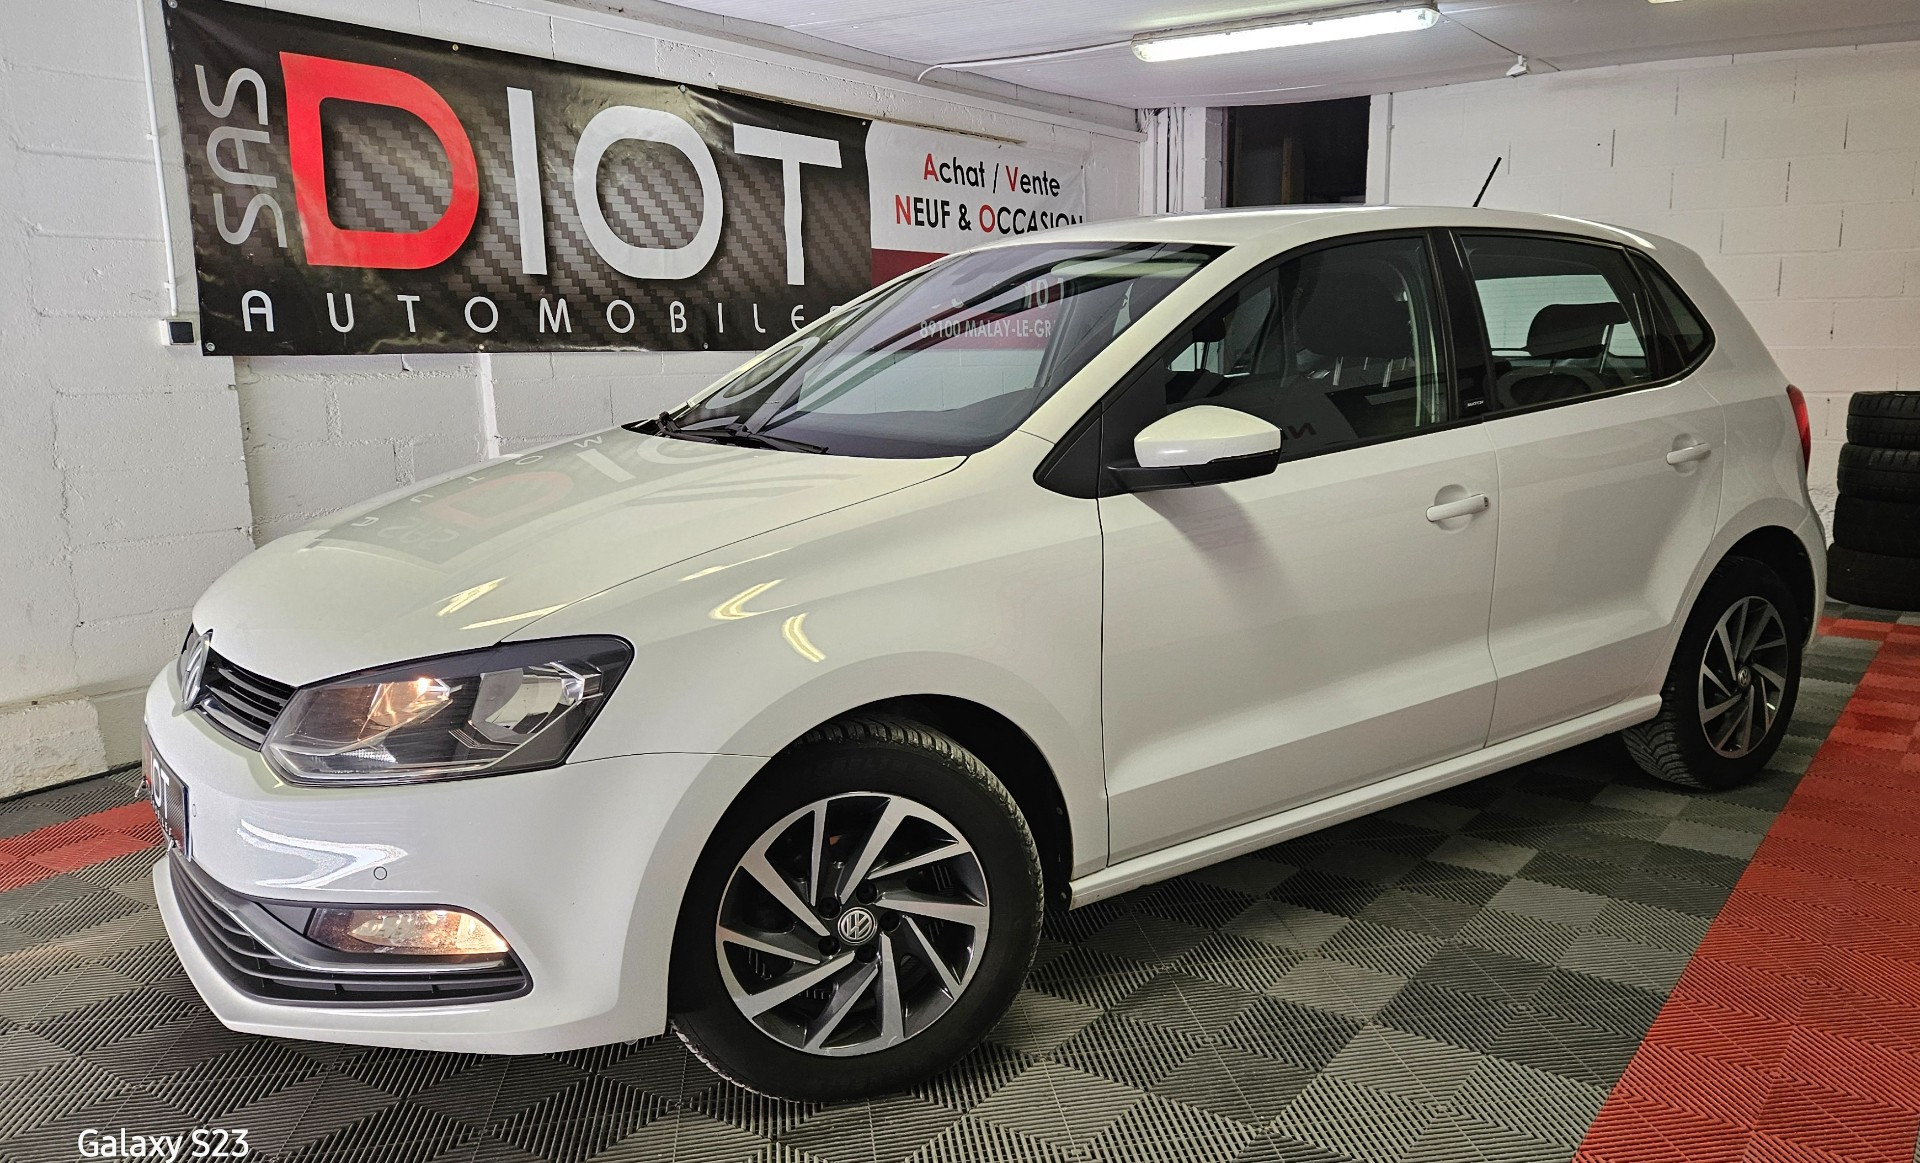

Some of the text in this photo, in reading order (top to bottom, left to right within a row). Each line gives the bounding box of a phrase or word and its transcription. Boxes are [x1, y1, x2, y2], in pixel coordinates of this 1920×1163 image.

[195, 64, 288, 248] SAS
[279, 51, 842, 287] DIOT
[923, 153, 985, 188] Achat
[1005, 165, 1061, 197] Vente
[895, 194, 950, 229] NEUF
[958, 204, 972, 231] &
[242, 289, 842, 334] AUTOMOBILE
[919, 319, 1056, 339] 89100 MALAY-LE-GR
